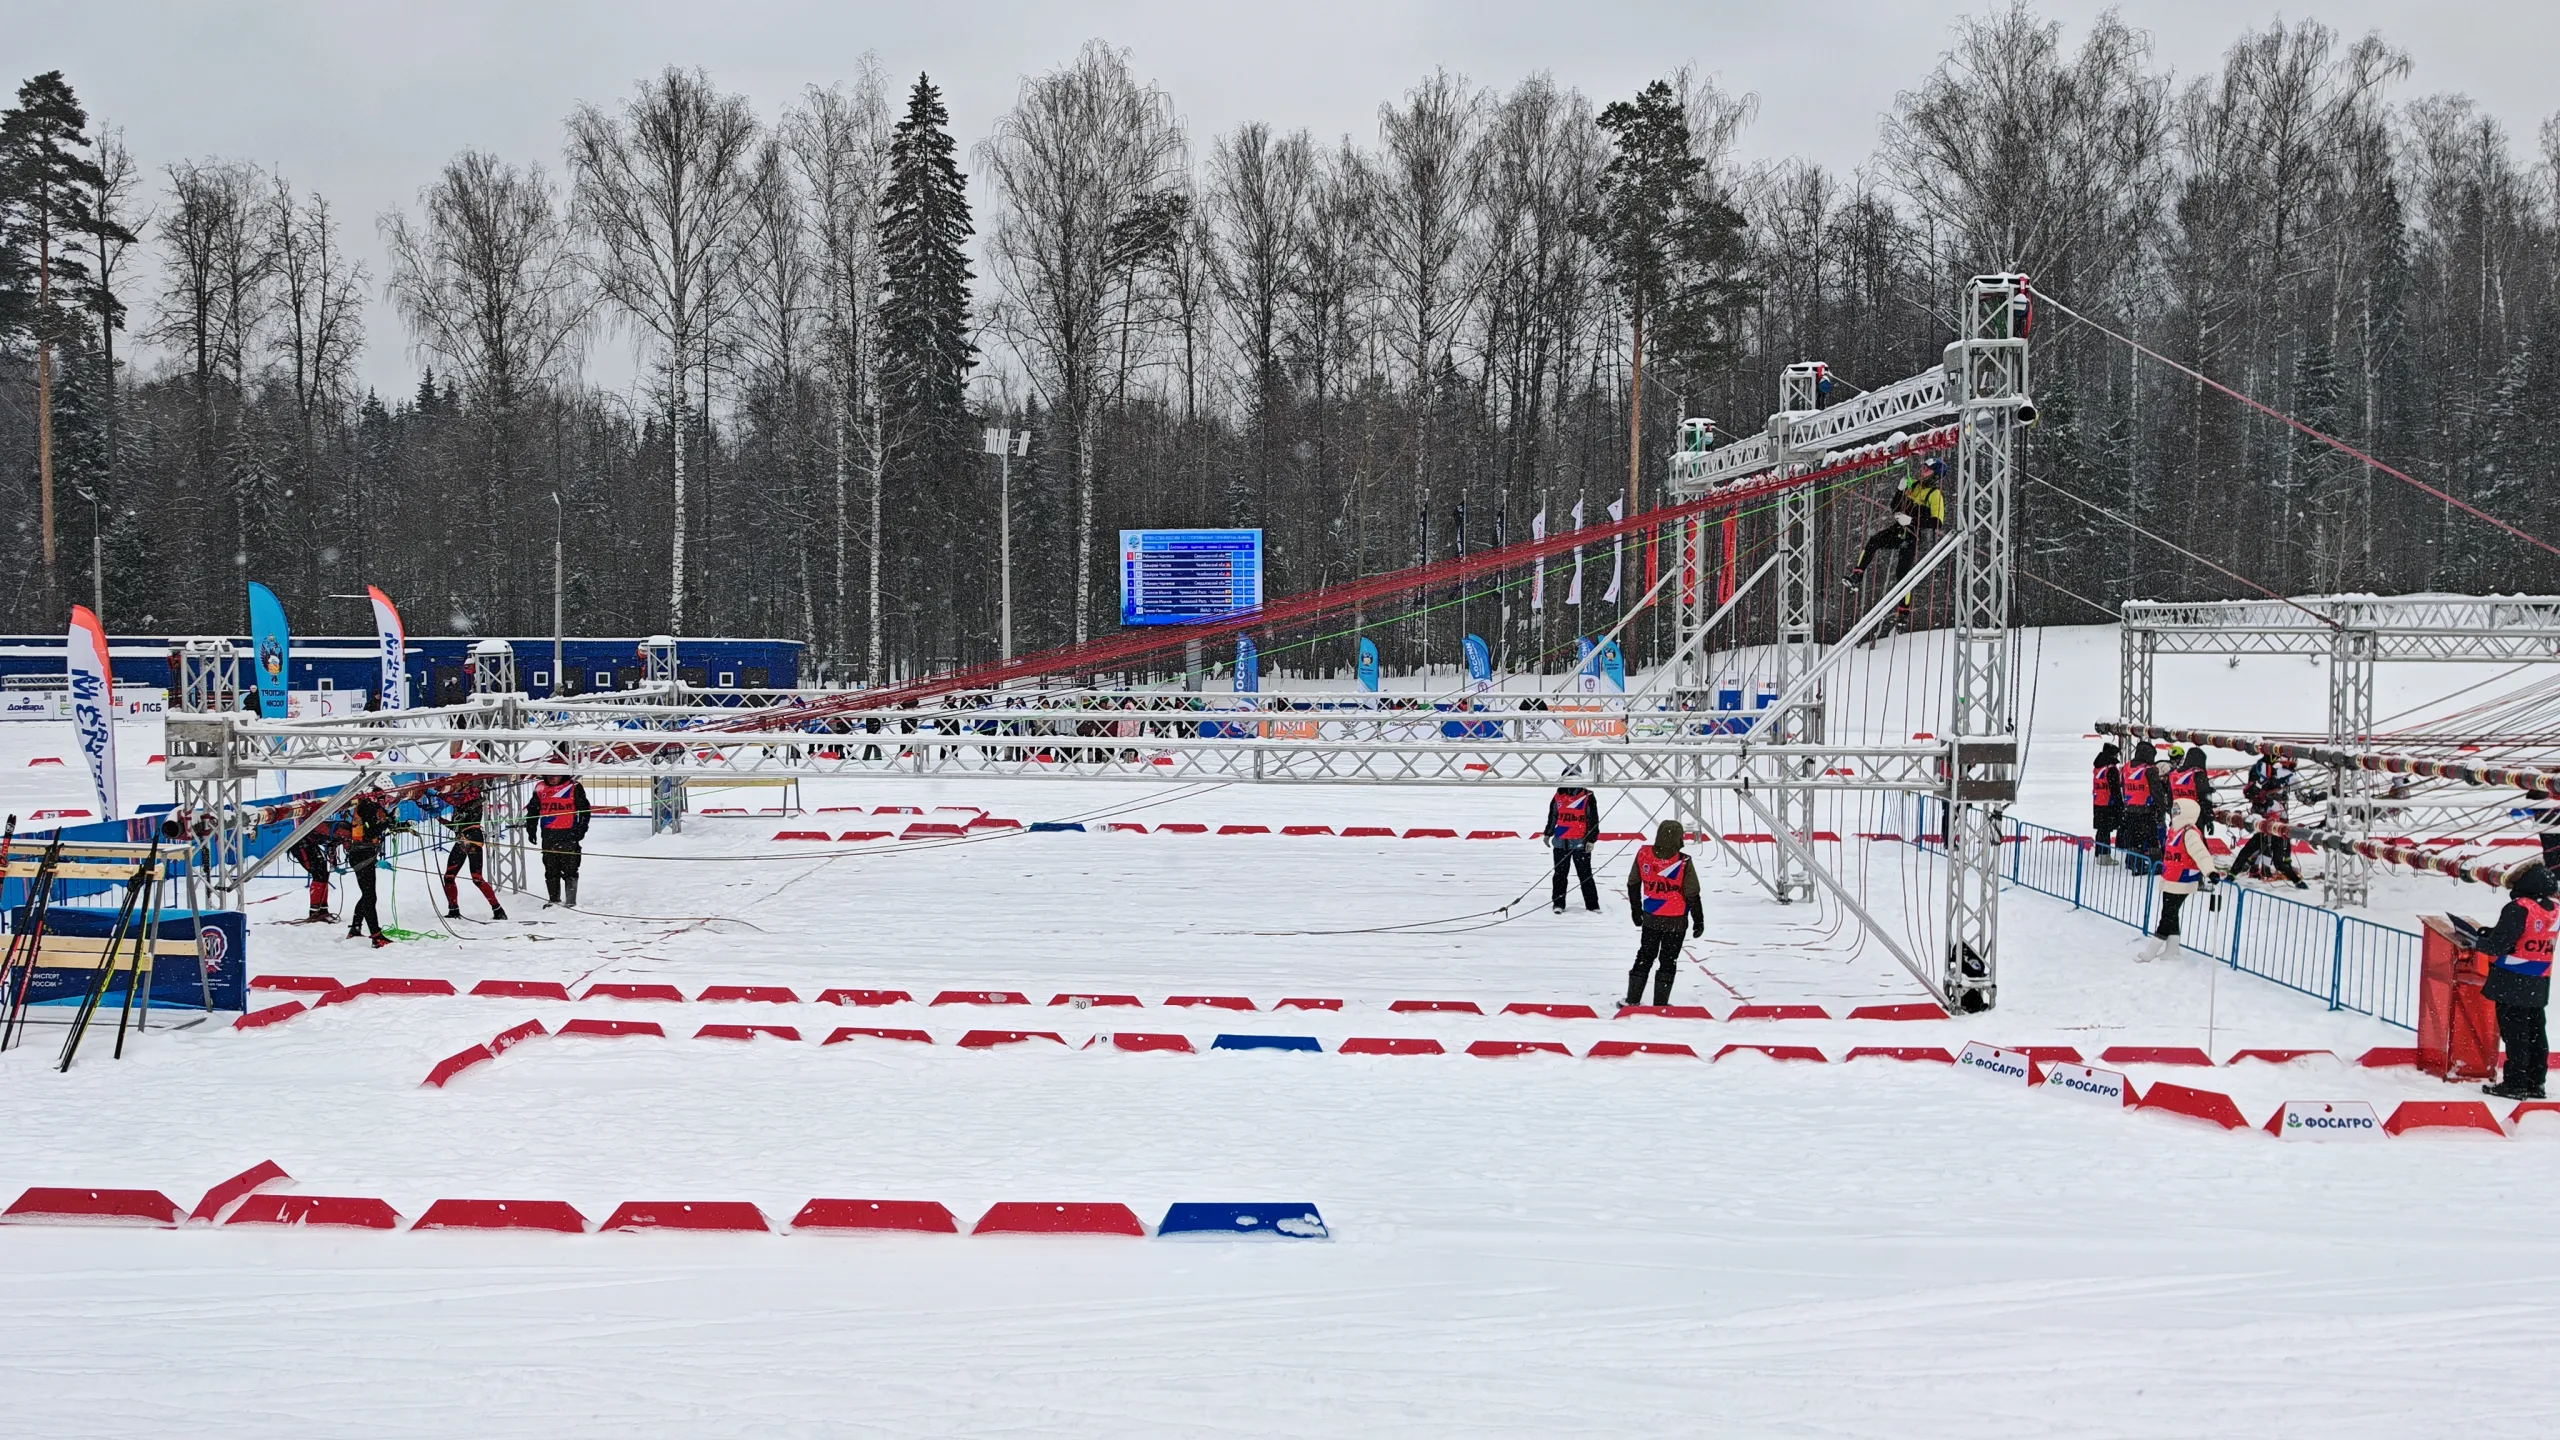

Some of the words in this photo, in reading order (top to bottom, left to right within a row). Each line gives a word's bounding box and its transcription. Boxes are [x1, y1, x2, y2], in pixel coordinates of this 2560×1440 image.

[142, 703, 162, 712] ПСБ
[2524, 939, 2555, 955] СУД
[1074, 1000, 1087, 1010] 30
[1975, 1058, 2024, 1078] ФОСАГРО
[2065, 1078, 2119, 1097] ФОСАГРО
[2305, 1117, 2373, 1129] ФОСАГРО
